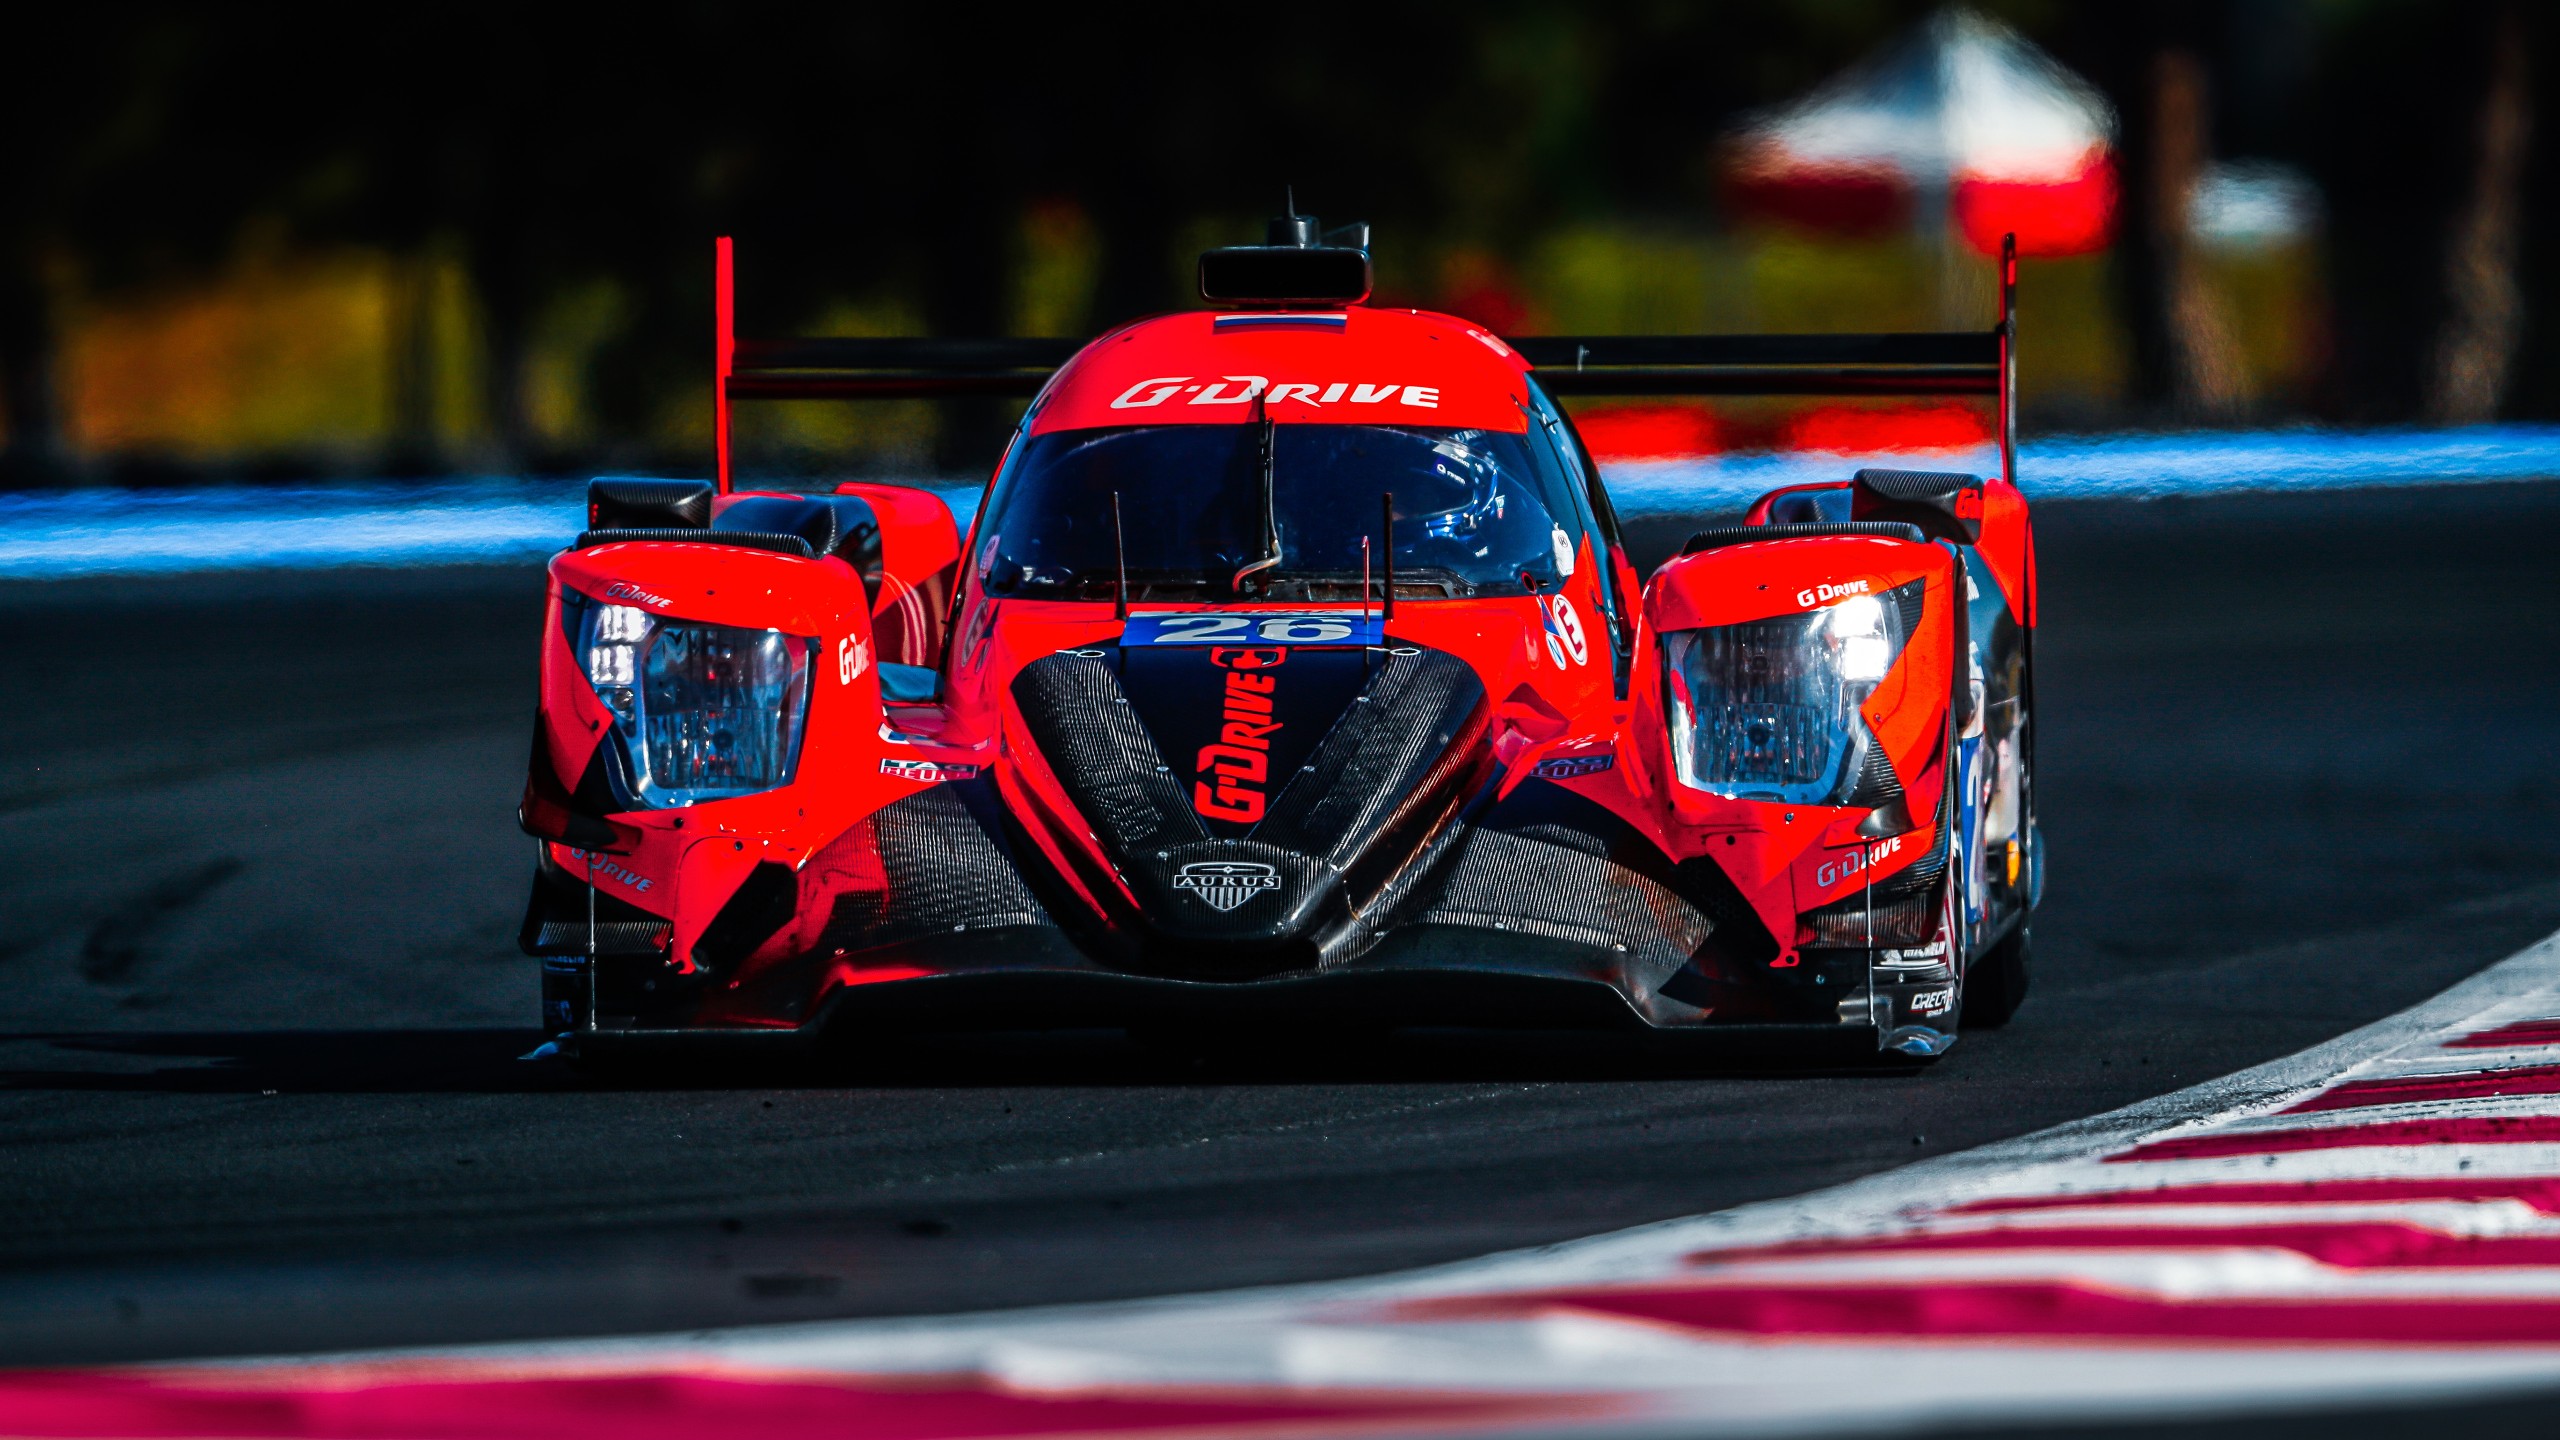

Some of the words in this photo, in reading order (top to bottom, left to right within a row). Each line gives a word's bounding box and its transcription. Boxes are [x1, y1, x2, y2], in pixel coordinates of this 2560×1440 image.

[1154, 617, 1352, 642] 26
[890, 760, 968, 772] TAG
[887, 767, 970, 781] HEU
[1179, 876, 1276, 888] AURUS
